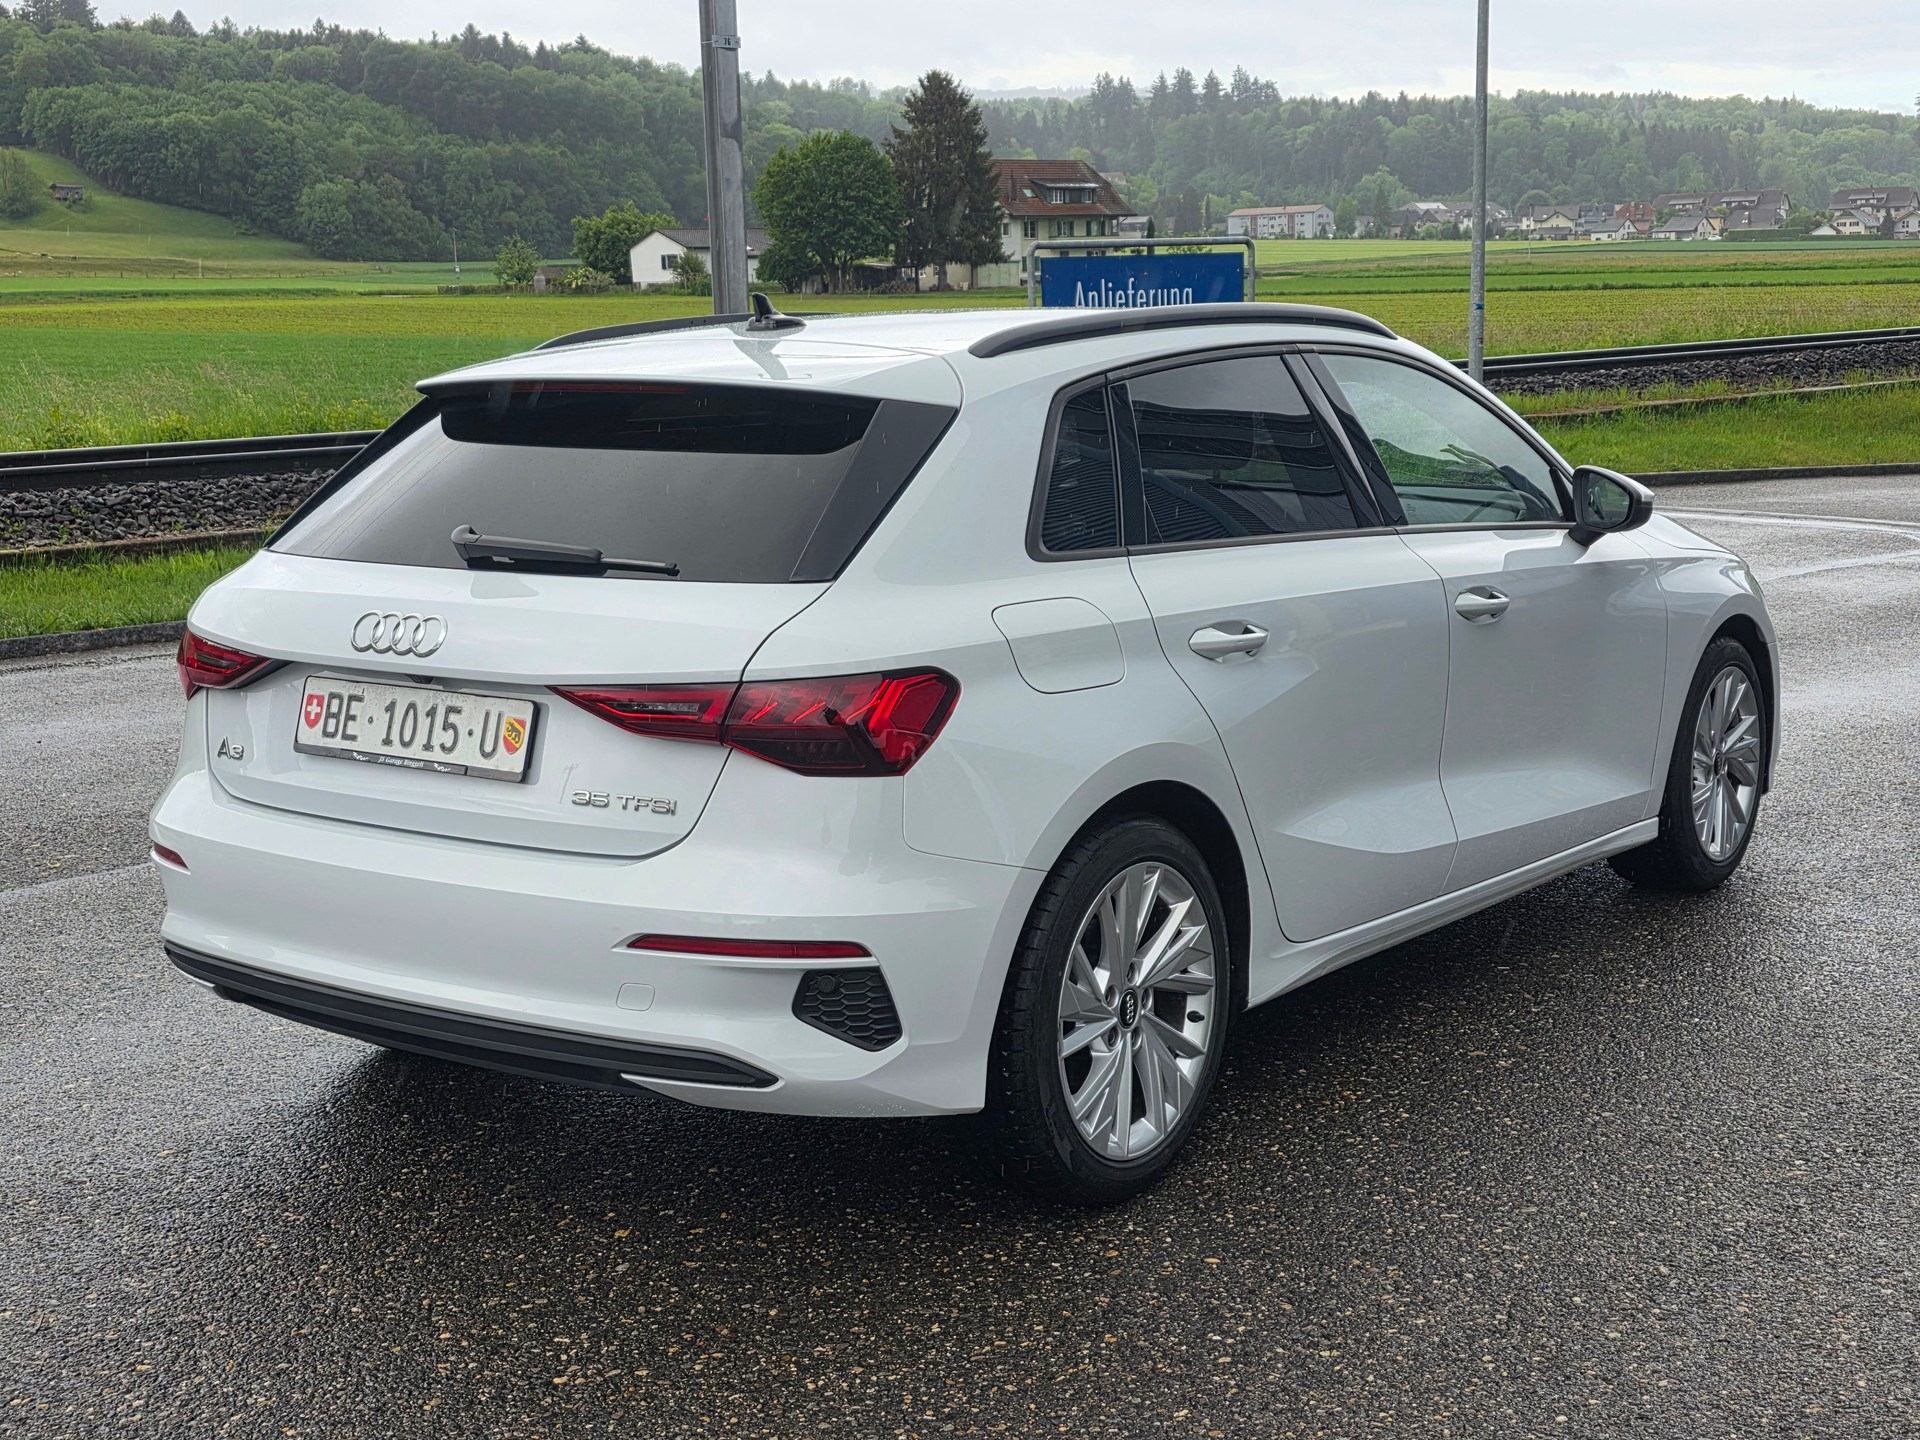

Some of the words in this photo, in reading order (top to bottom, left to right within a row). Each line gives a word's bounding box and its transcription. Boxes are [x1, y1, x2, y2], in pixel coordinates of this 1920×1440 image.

[217, 736, 244, 761] A3
[385, 757, 404, 766] Garage
[571, 789, 610, 808] 35
[616, 793, 678, 816] TFSI
